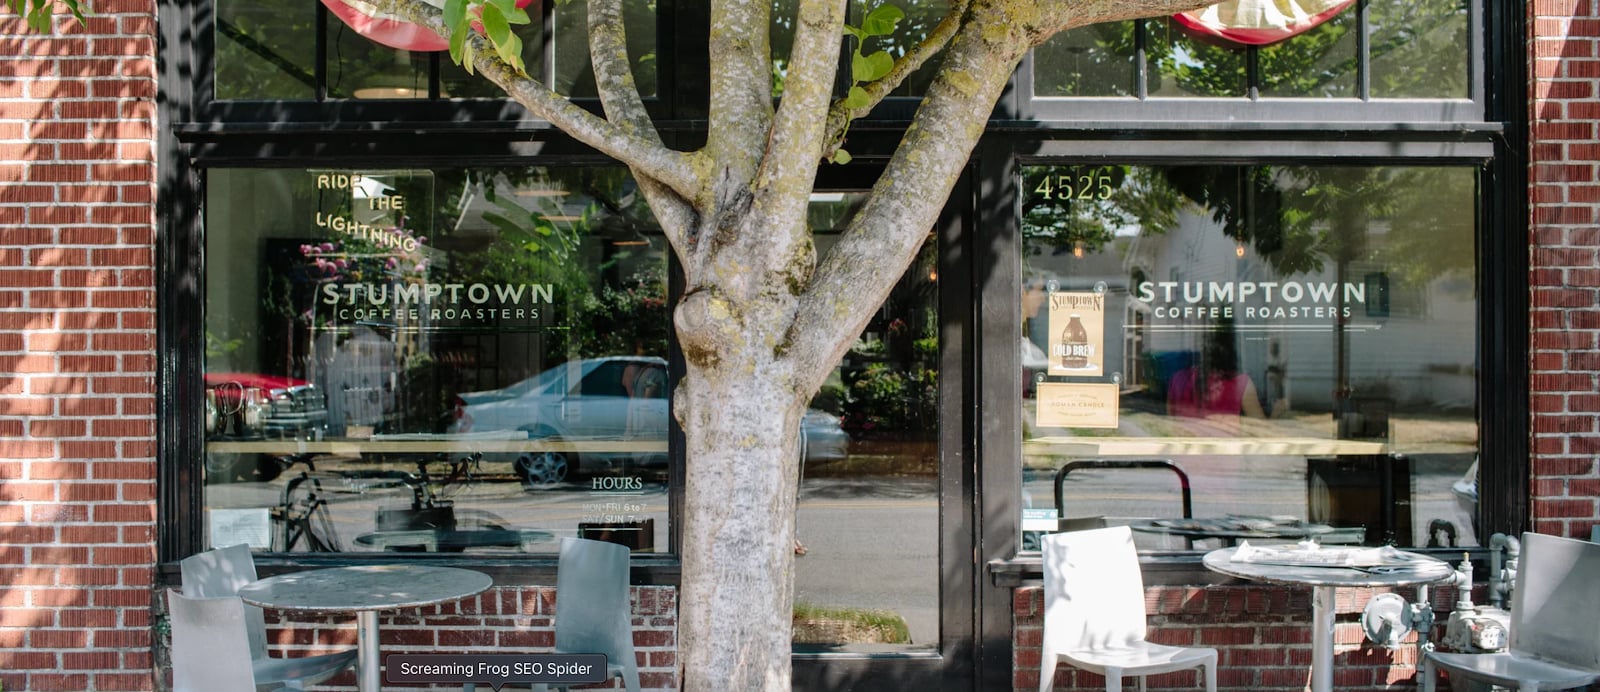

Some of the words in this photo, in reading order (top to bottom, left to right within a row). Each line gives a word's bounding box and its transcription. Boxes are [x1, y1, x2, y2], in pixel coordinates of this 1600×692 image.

[317, 174, 361, 190] RIDE
[1034, 175, 1112, 200] 4525
[368, 194, 404, 210] THE
[316, 211, 418, 252] LIGHTNING
[323, 283, 553, 304] STUMPTOWN
[1138, 281, 1366, 303] STUMPTOWN
[339, 308, 419, 321] COFFEE
[430, 308, 539, 321] ROASTERS
[1154, 306, 1234, 319] COFFEE
[1245, 306, 1351, 319] ROASTERS
[1053, 343, 1072, 357] COLD
[1072, 344, 1095, 358] BREW
[592, 477, 643, 490] HOURS
